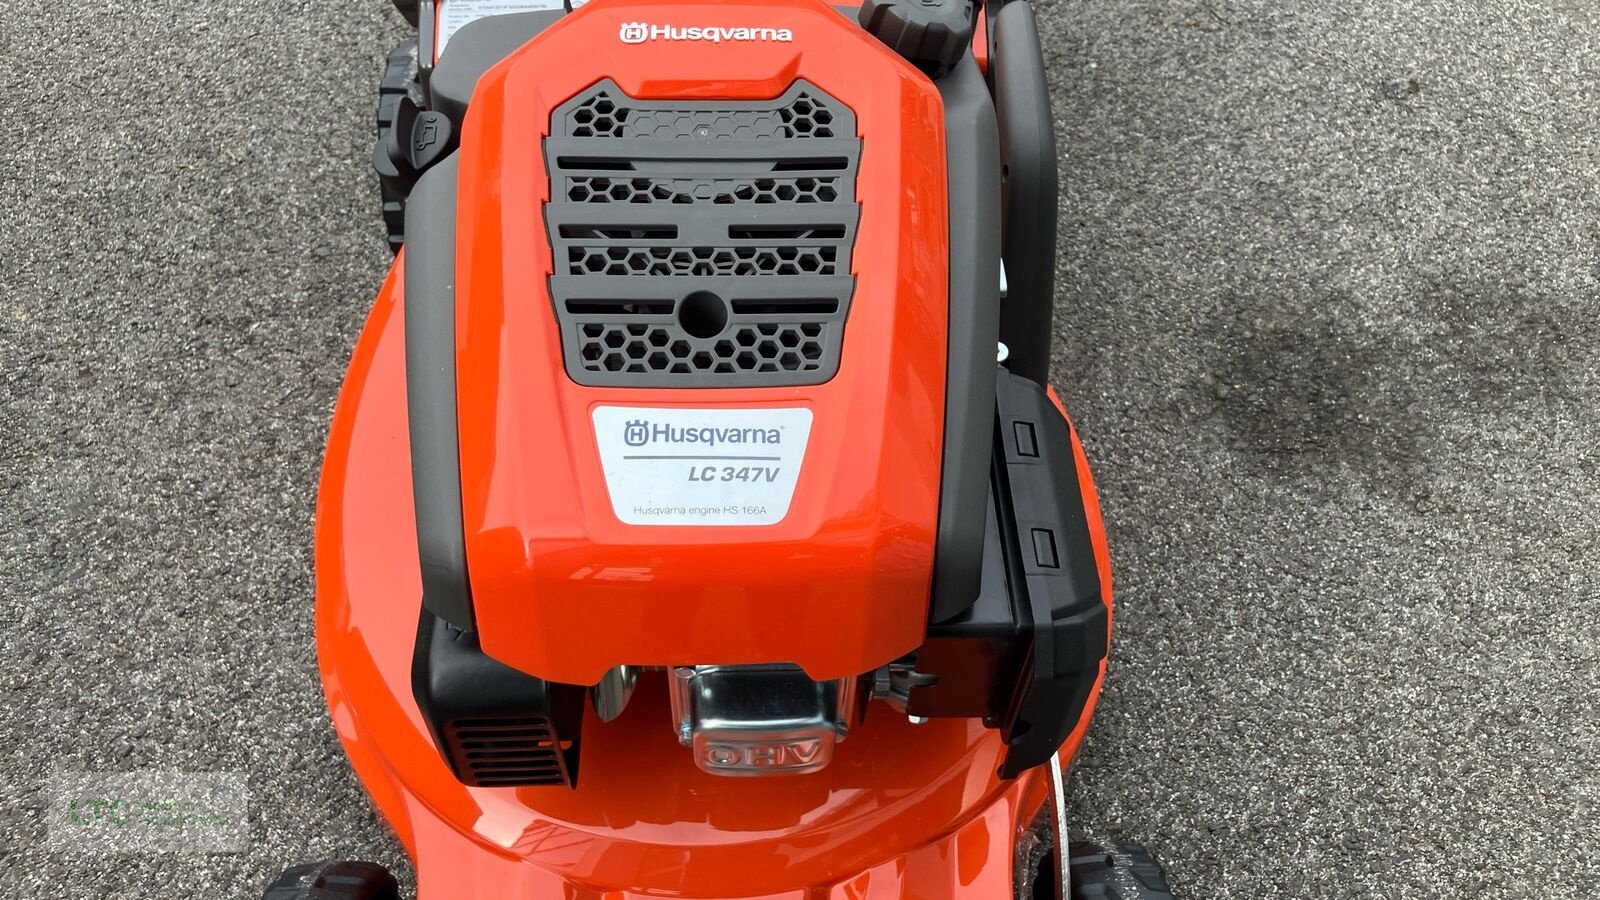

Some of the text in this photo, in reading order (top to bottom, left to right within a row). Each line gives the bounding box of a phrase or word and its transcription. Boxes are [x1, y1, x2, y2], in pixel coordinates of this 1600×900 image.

[650, 24, 793, 42] Husqvarna
[652, 423, 782, 446] Husqvarna
[688, 466, 780, 483] LC 347V
[633, 505, 767, 516] Husqvarna engine HS 166A
[706, 743, 821, 765] OHV
